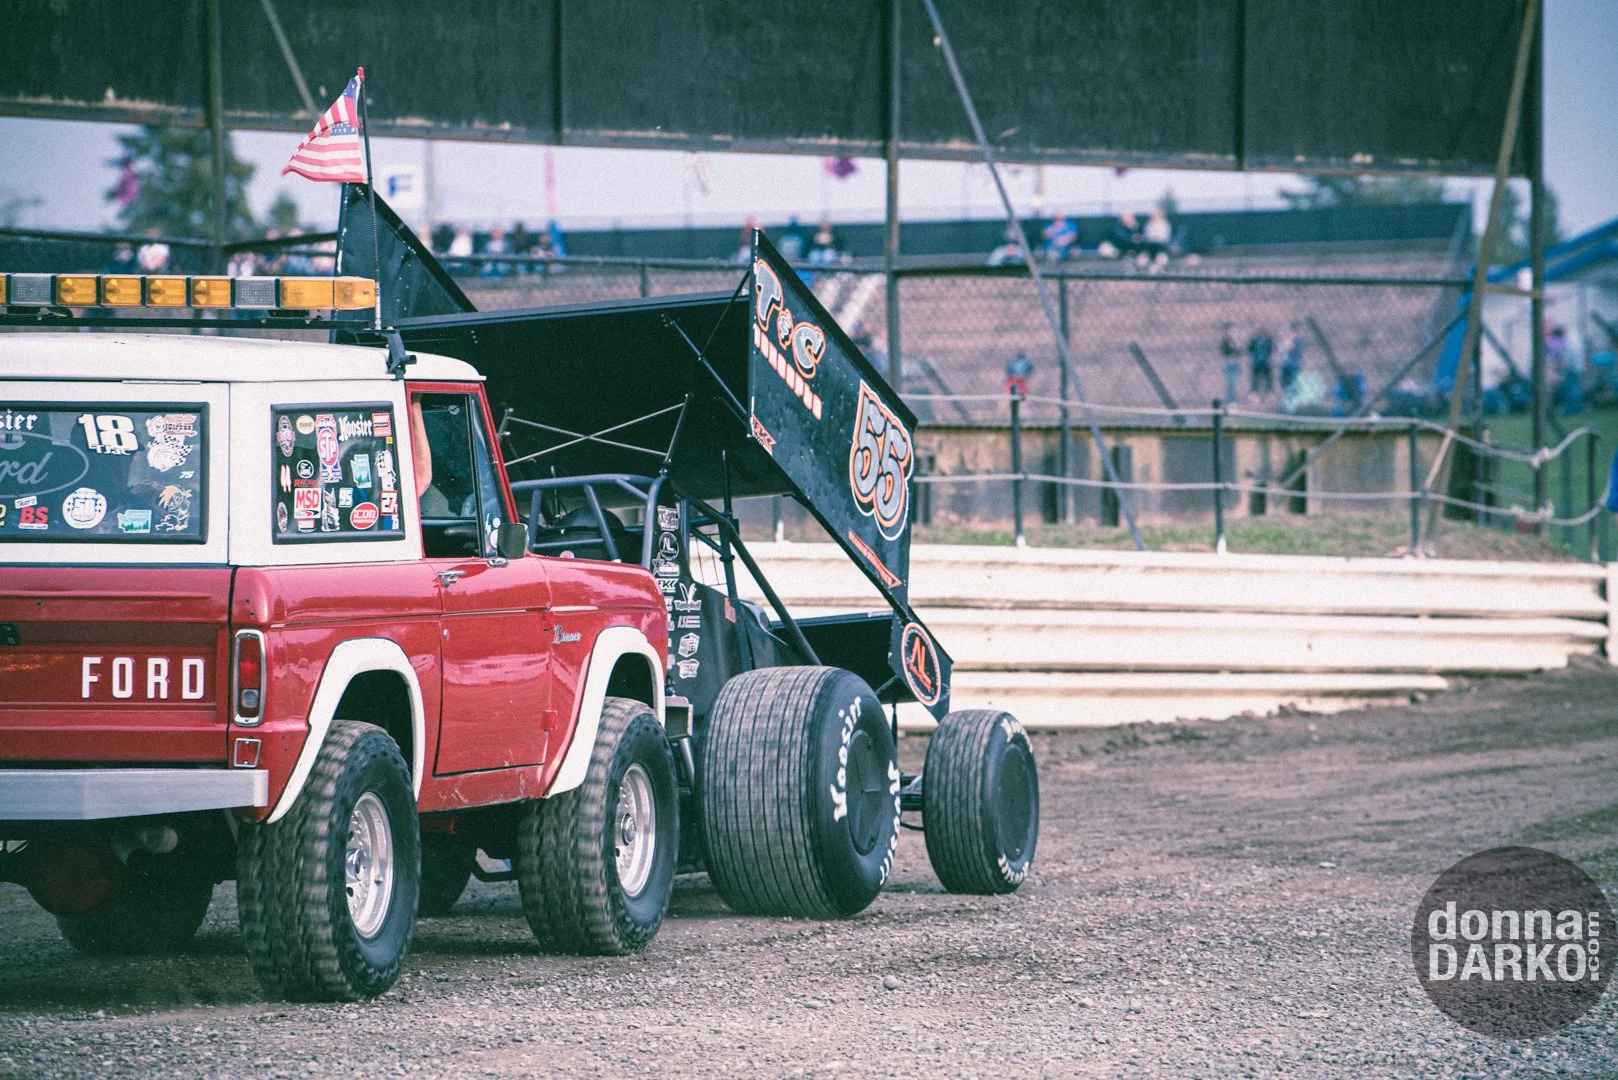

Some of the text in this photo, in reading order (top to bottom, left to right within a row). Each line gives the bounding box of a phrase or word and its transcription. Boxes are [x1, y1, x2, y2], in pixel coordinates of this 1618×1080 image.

[78, 413, 139, 451] 18
[853, 383, 911, 532] 55
[20, 506, 49, 524] BS
[296, 489, 320, 509] MSD
[81, 656, 206, 700] FORD
